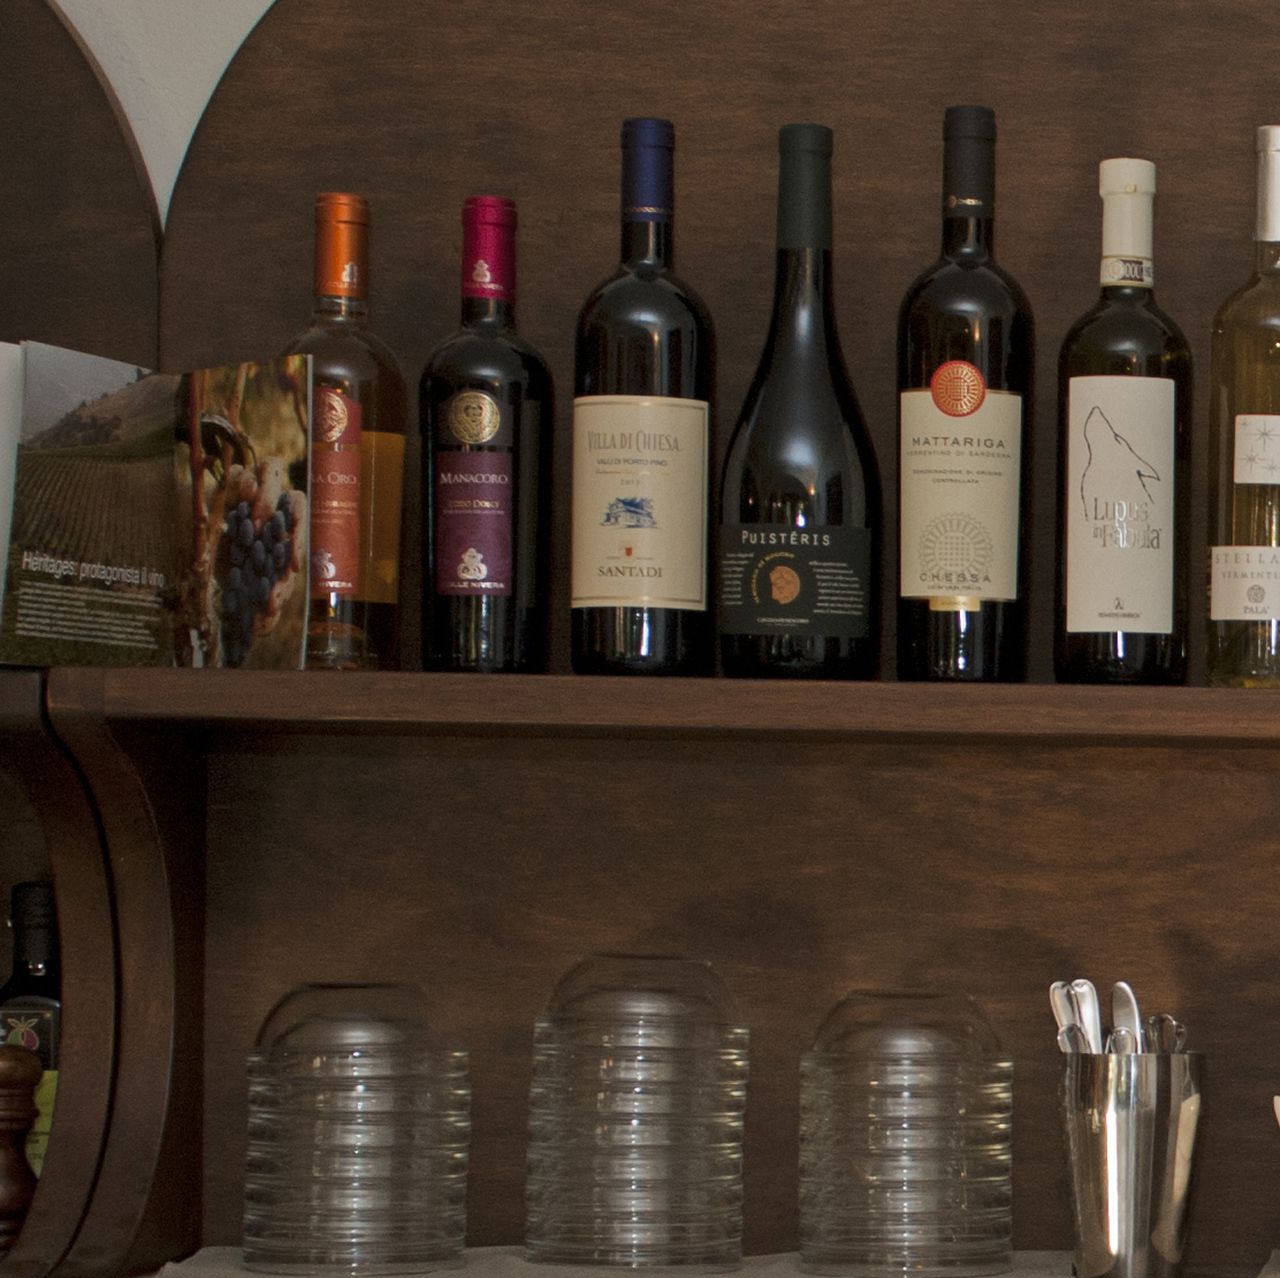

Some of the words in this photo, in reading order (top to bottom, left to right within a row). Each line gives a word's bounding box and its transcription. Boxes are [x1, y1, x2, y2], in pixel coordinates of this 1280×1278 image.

[588, 430, 616, 452] VILLA
[620, 432, 632, 450] DI
[636, 430, 682, 453] CHIESA
[598, 566, 663, 578] SANTADI
